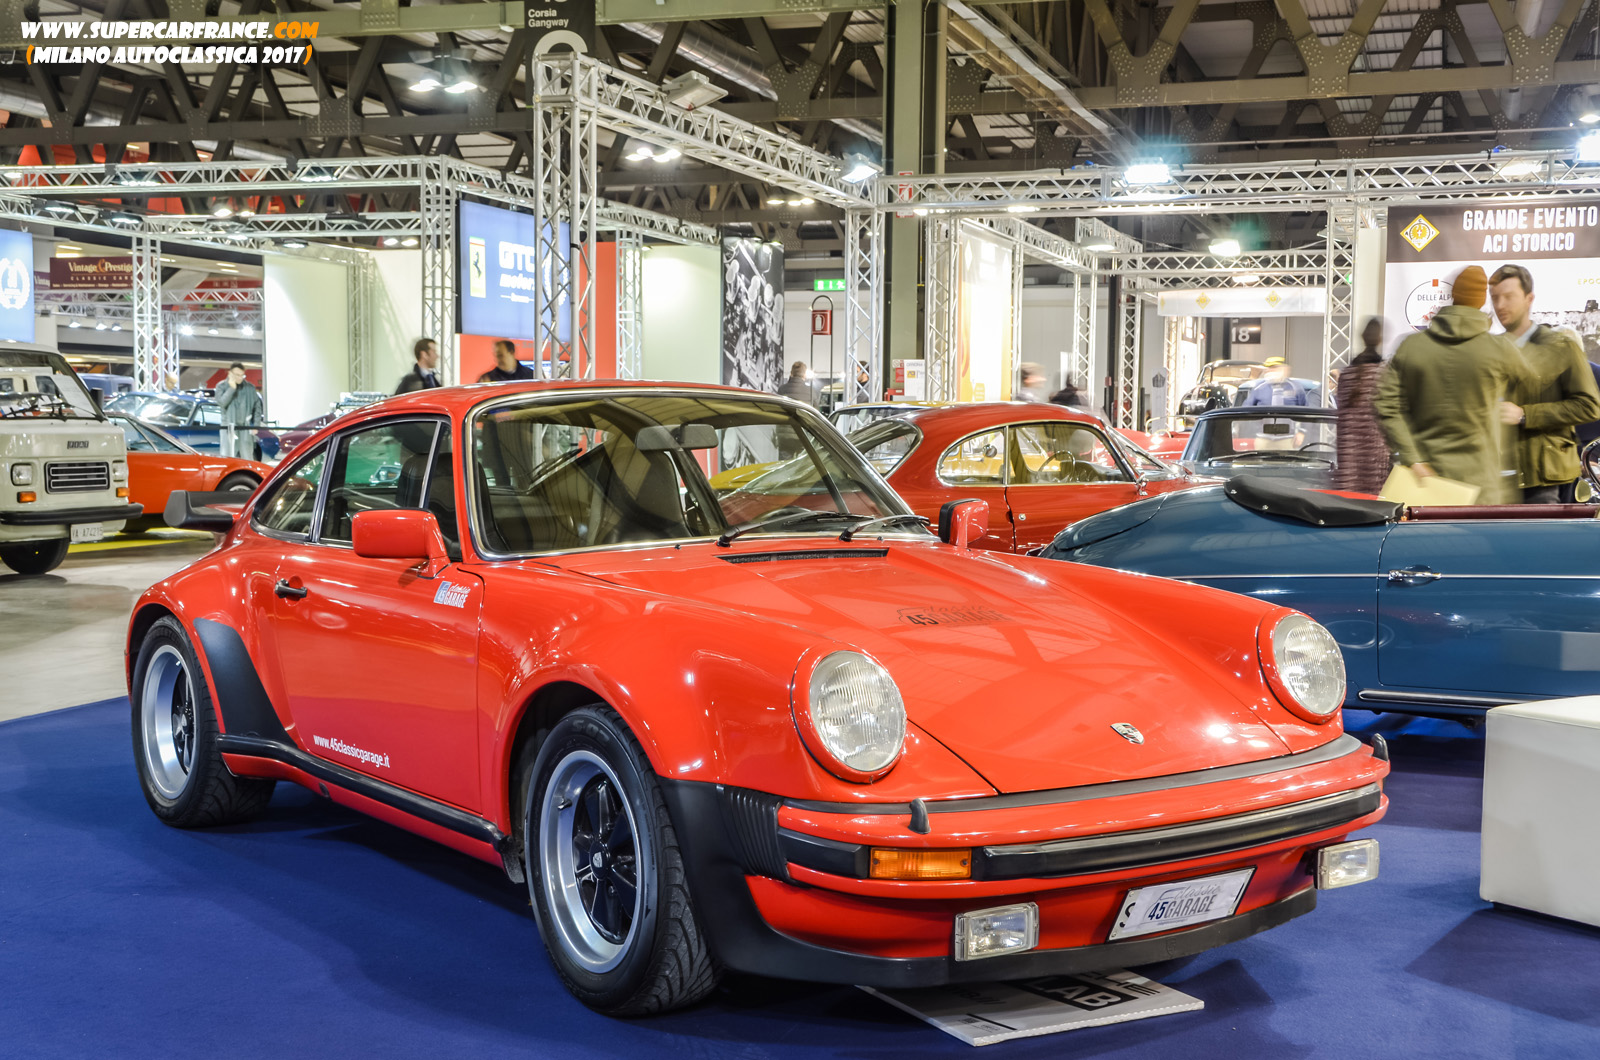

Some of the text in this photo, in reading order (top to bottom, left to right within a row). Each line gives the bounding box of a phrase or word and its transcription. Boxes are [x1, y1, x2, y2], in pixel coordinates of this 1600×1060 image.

[528, 8, 557, 18] Corsia
[528, 19, 569, 28] Gangway
[1463, 205, 1598, 231] GRANDE EVENTO
[1483, 232, 1575, 253] ACI STORICO
[313, 734, 390, 768] www.45classicgarage.it
